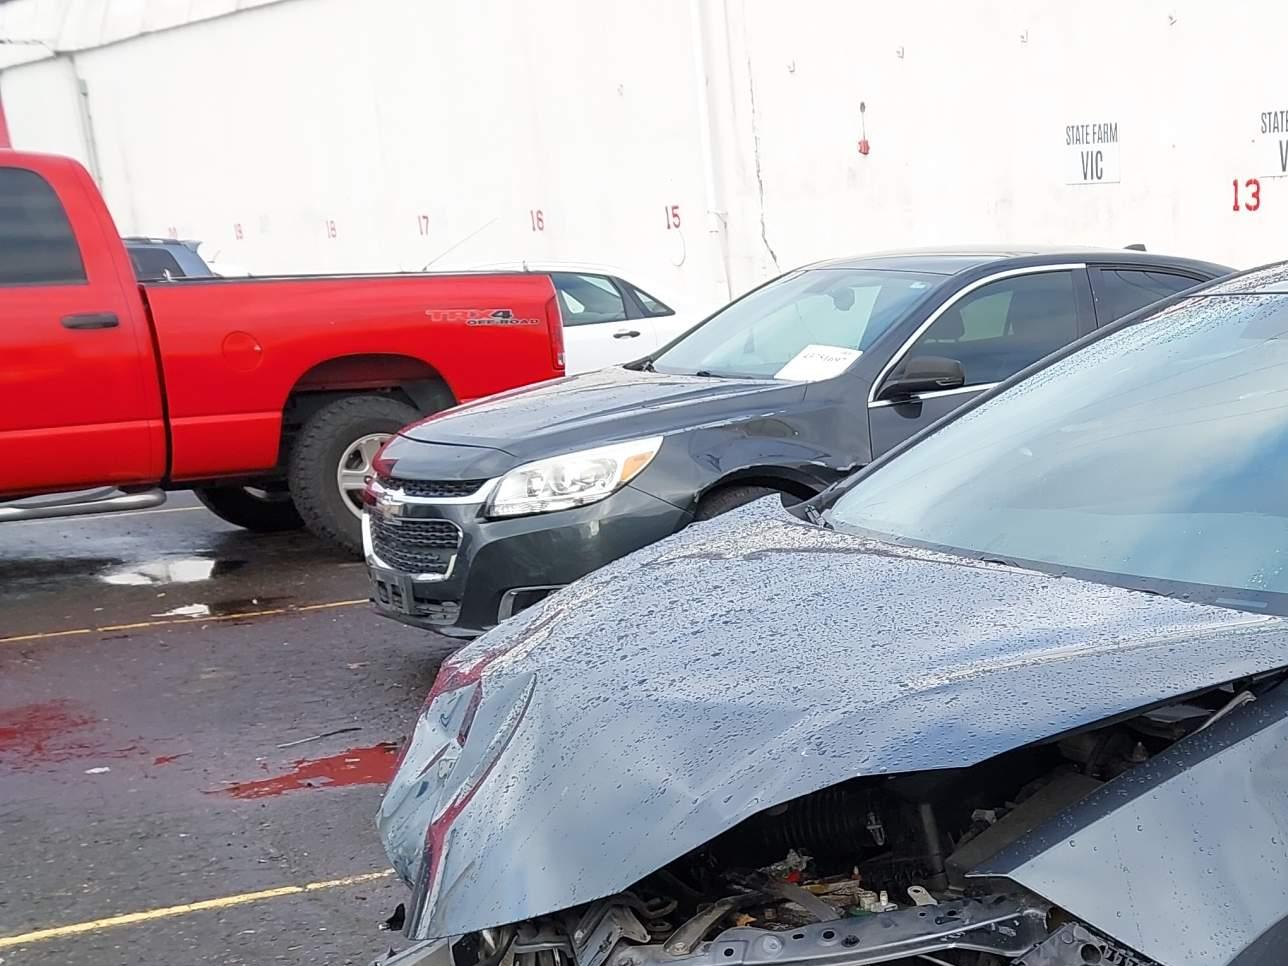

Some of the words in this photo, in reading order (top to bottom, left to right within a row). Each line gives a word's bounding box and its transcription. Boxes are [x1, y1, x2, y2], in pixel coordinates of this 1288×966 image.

[1065, 124, 1091, 146] STATE
[1092, 122, 1118, 144] FARM
[1081, 150, 1104, 181] VIC
[1232, 178, 1261, 212] 13
[417, 214, 430, 236] 17
[530, 209, 545, 232] 16
[664, 205, 682, 230] 15
